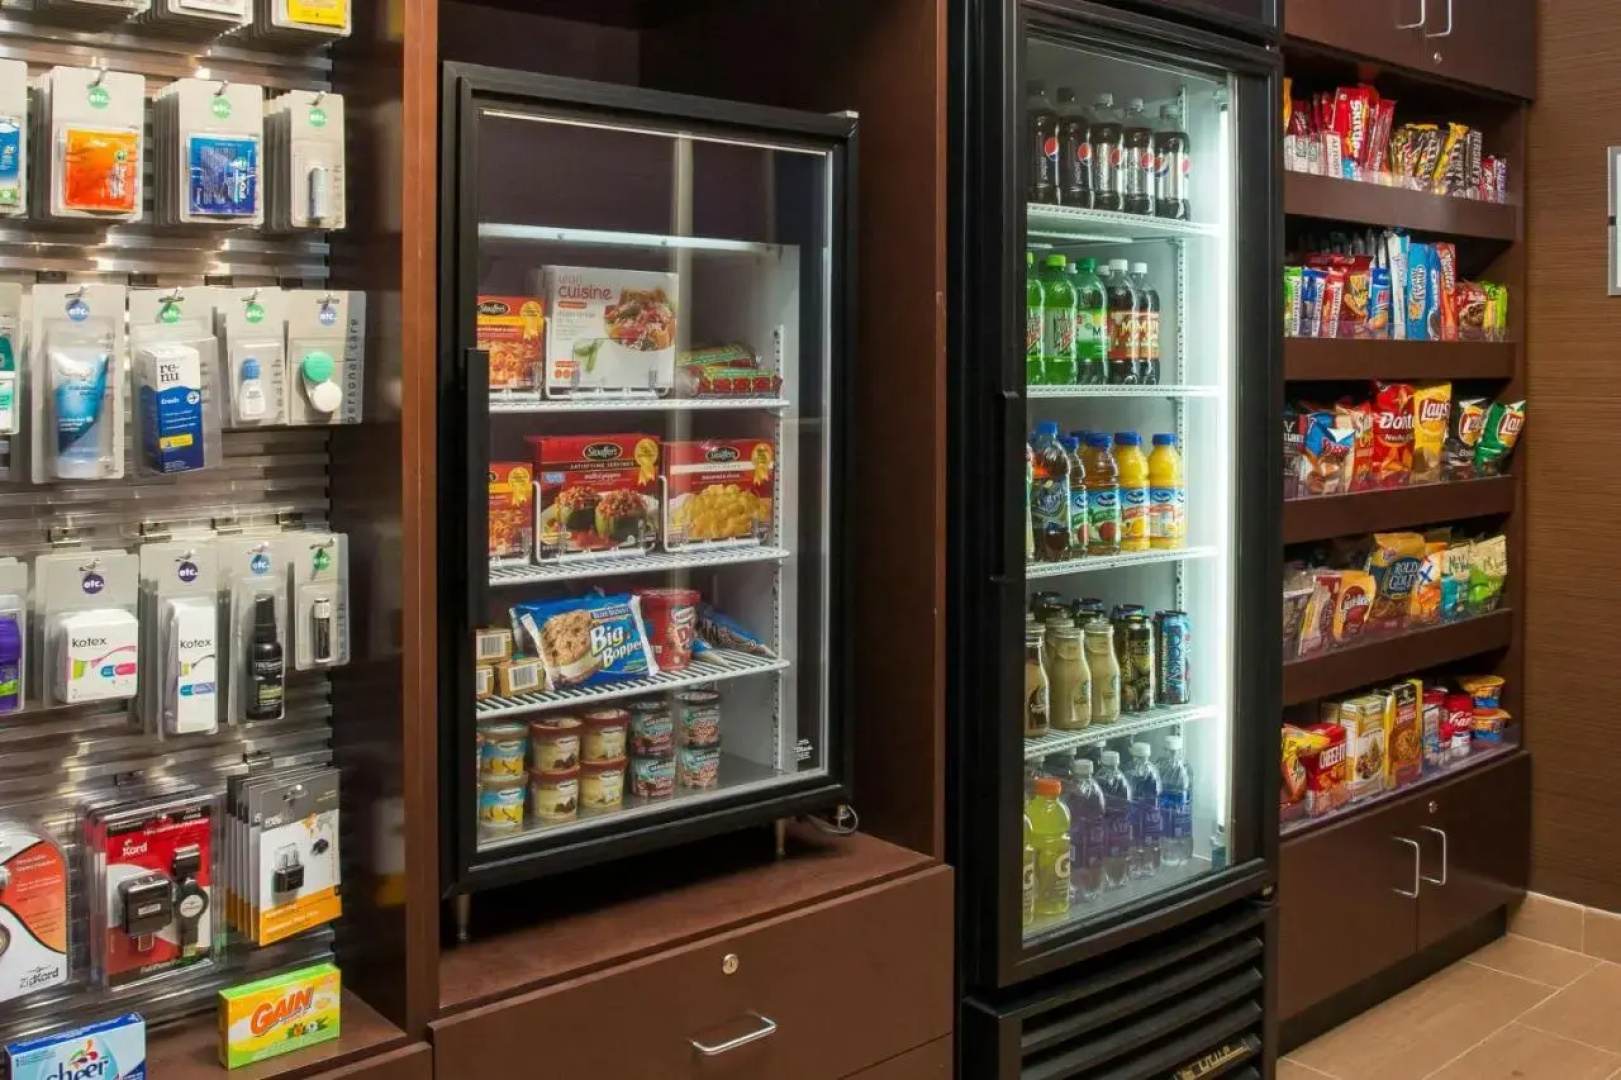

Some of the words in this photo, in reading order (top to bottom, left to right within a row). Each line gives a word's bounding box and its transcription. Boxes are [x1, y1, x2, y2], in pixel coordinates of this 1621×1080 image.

[558, 284, 613, 301] cuisine
[68, 307, 90, 317] etc.
[347, 358, 358, 425] personal
[1380, 412, 1414, 429] Dorit
[180, 566, 198, 576] etc.
[83, 579, 104, 589] etc.
[590, 623, 624, 657] Big
[602, 640, 644, 668] Bopper
[46, 1056, 110, 1080] cheer
